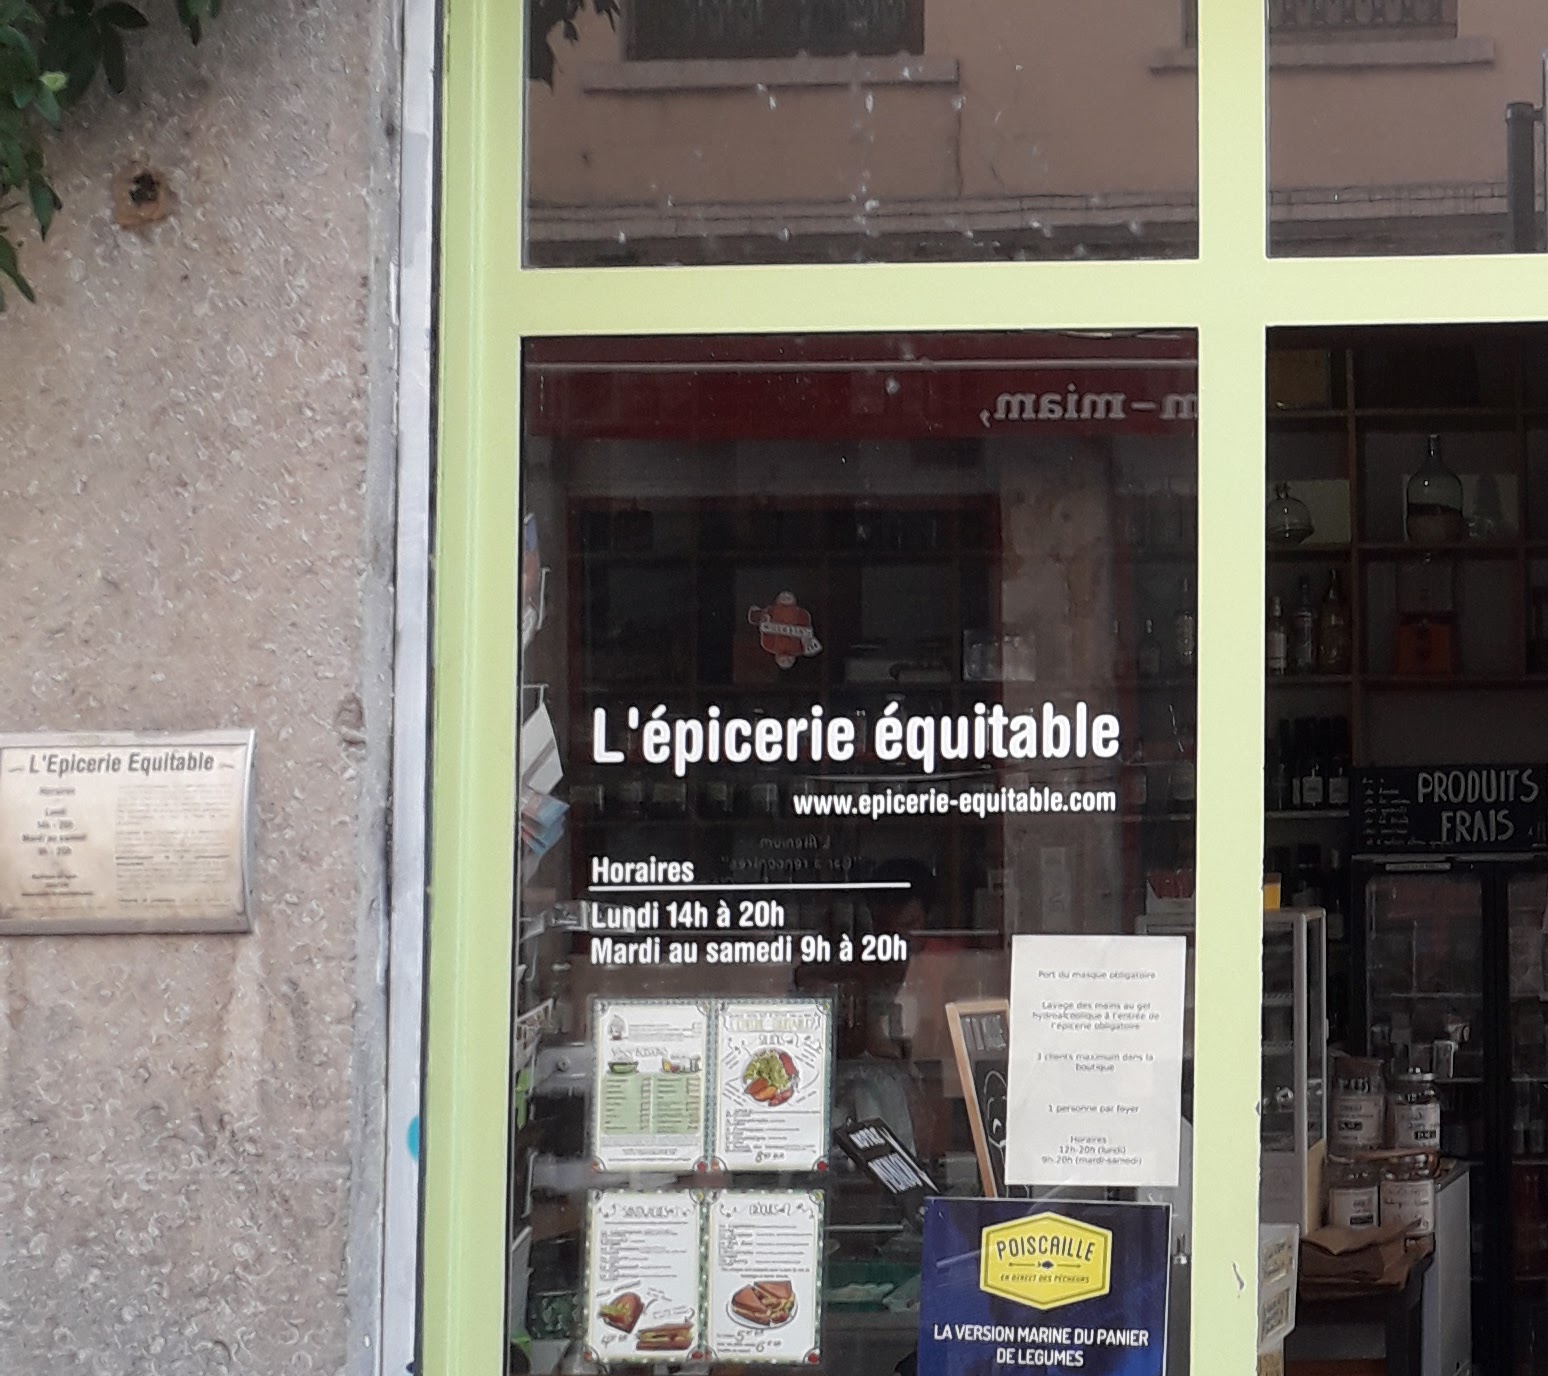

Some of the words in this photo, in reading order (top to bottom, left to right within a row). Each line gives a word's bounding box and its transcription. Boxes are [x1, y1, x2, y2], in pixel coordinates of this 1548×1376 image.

[592, 704, 857, 777] L'épicerie
[874, 701, 1121, 774] équitable
[29, 752, 122, 779] L'Epicerie
[127, 751, 215, 777] Equitable
[1417, 768, 1540, 804] PRODUITS
[793, 787, 1118, 821] www.epicerie-equitable.com
[1440, 808, 1516, 843] FRAIS
[591, 856, 694, 884] Horaires
[590, 901, 660, 930] Lundi
[666, 900, 708, 929] 14h
[716, 901, 731, 928] à
[738, 899, 785, 928] 20h
[590, 936, 661, 965] Mardi
[668, 942, 698, 964] au
[705, 934, 793, 964] samedi
[801, 934, 831, 963] 9h
[838, 936, 855, 963] à
[861, 933, 908, 962] 20h
[995, 1234, 1097, 1263] POISCAILLE
[933, 1323, 953, 1341] LA
[954, 1324, 1015, 1343] VERSION
[1017, 1326, 1072, 1345] MARINE
[1074, 1327, 1095, 1345] DU
[1096, 1328, 1149, 1347] PANIER
[996, 1348, 1017, 1365] DE
[1018, 1348, 1085, 1368] LEGUMES
